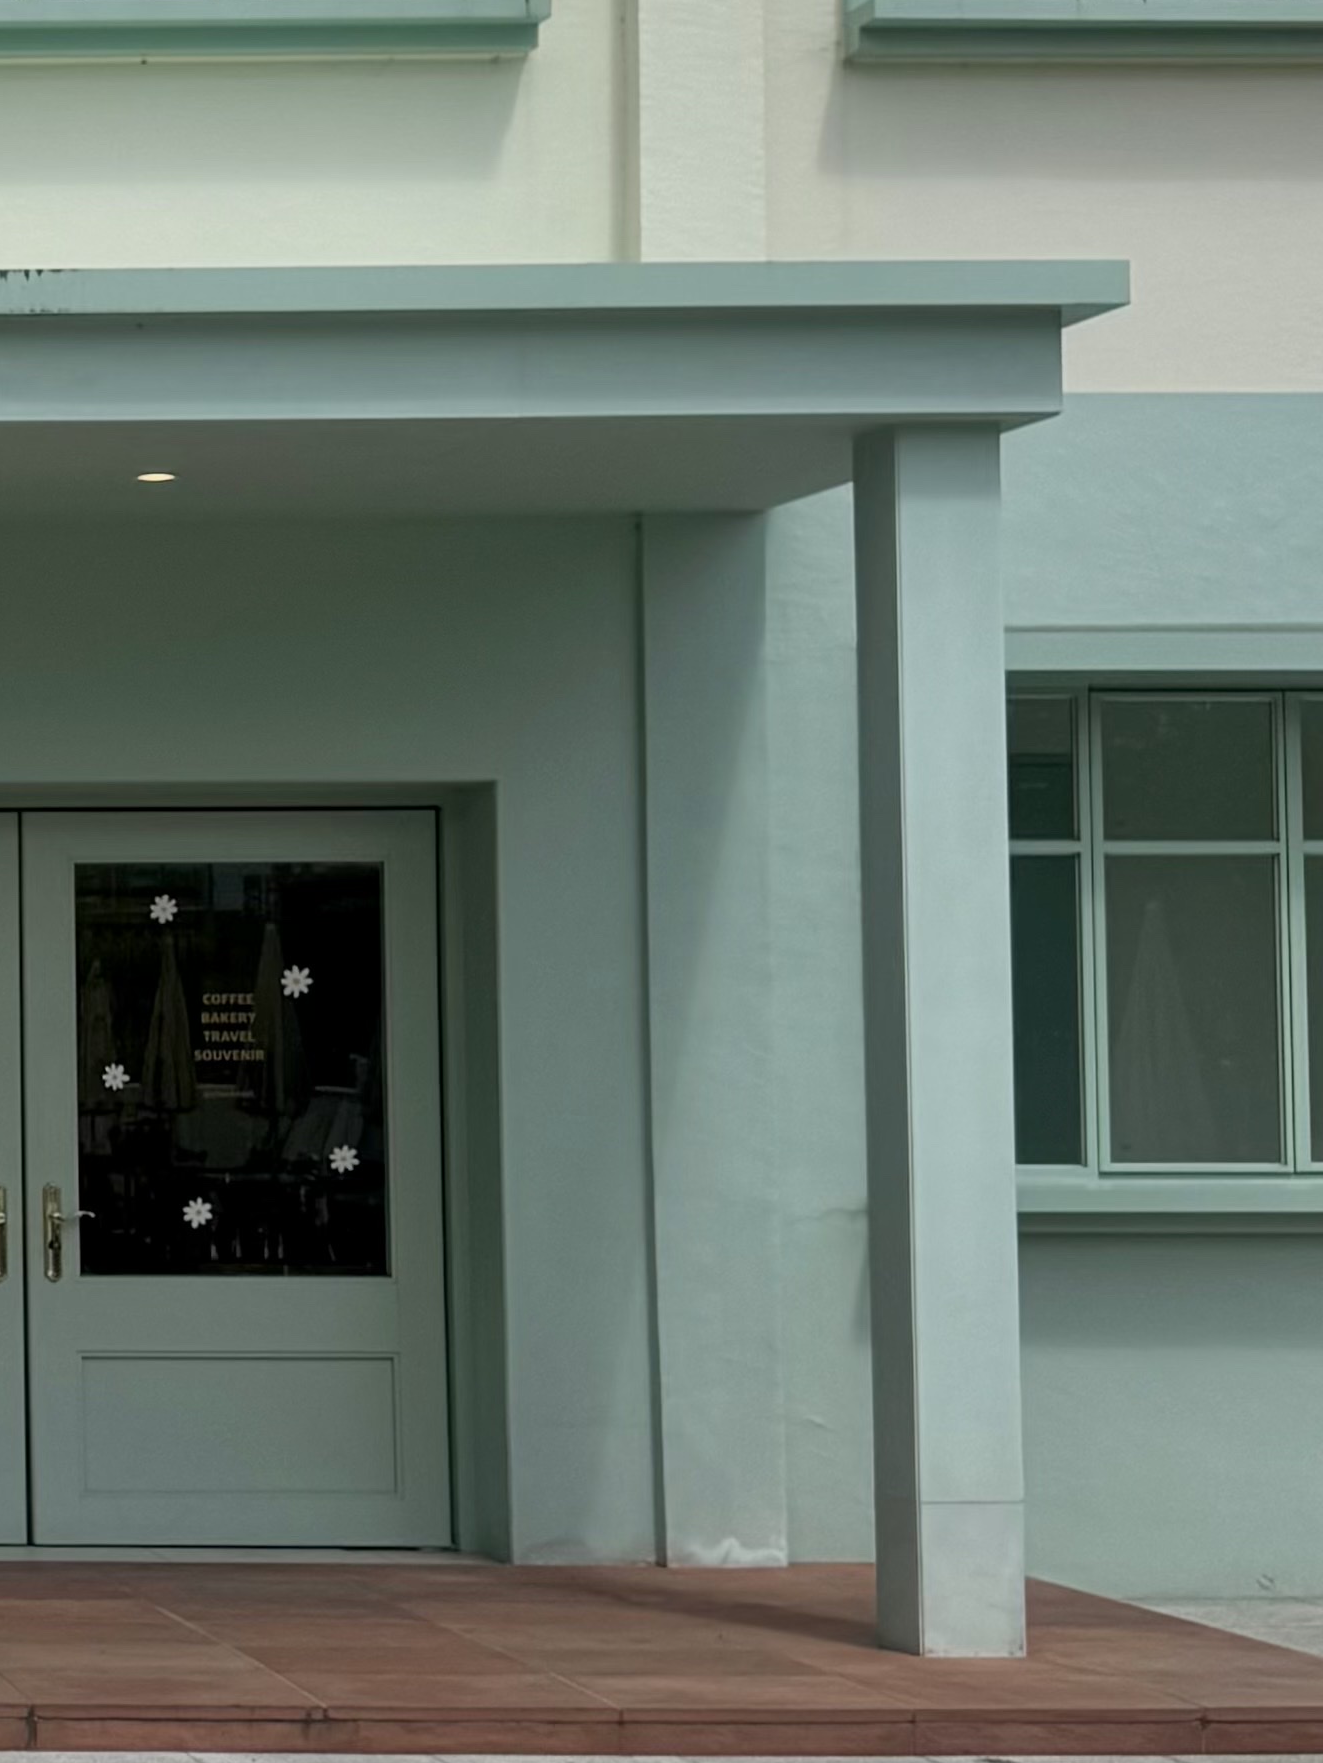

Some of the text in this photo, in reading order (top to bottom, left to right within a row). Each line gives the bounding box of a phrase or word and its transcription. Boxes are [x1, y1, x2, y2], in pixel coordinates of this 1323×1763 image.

[202, 993, 255, 1006] COFFEE
[201, 1011, 256, 1025] BAKERY
[202, 1030, 256, 1043] TRAVEL
[193, 1048, 266, 1062] SOUVENIR
